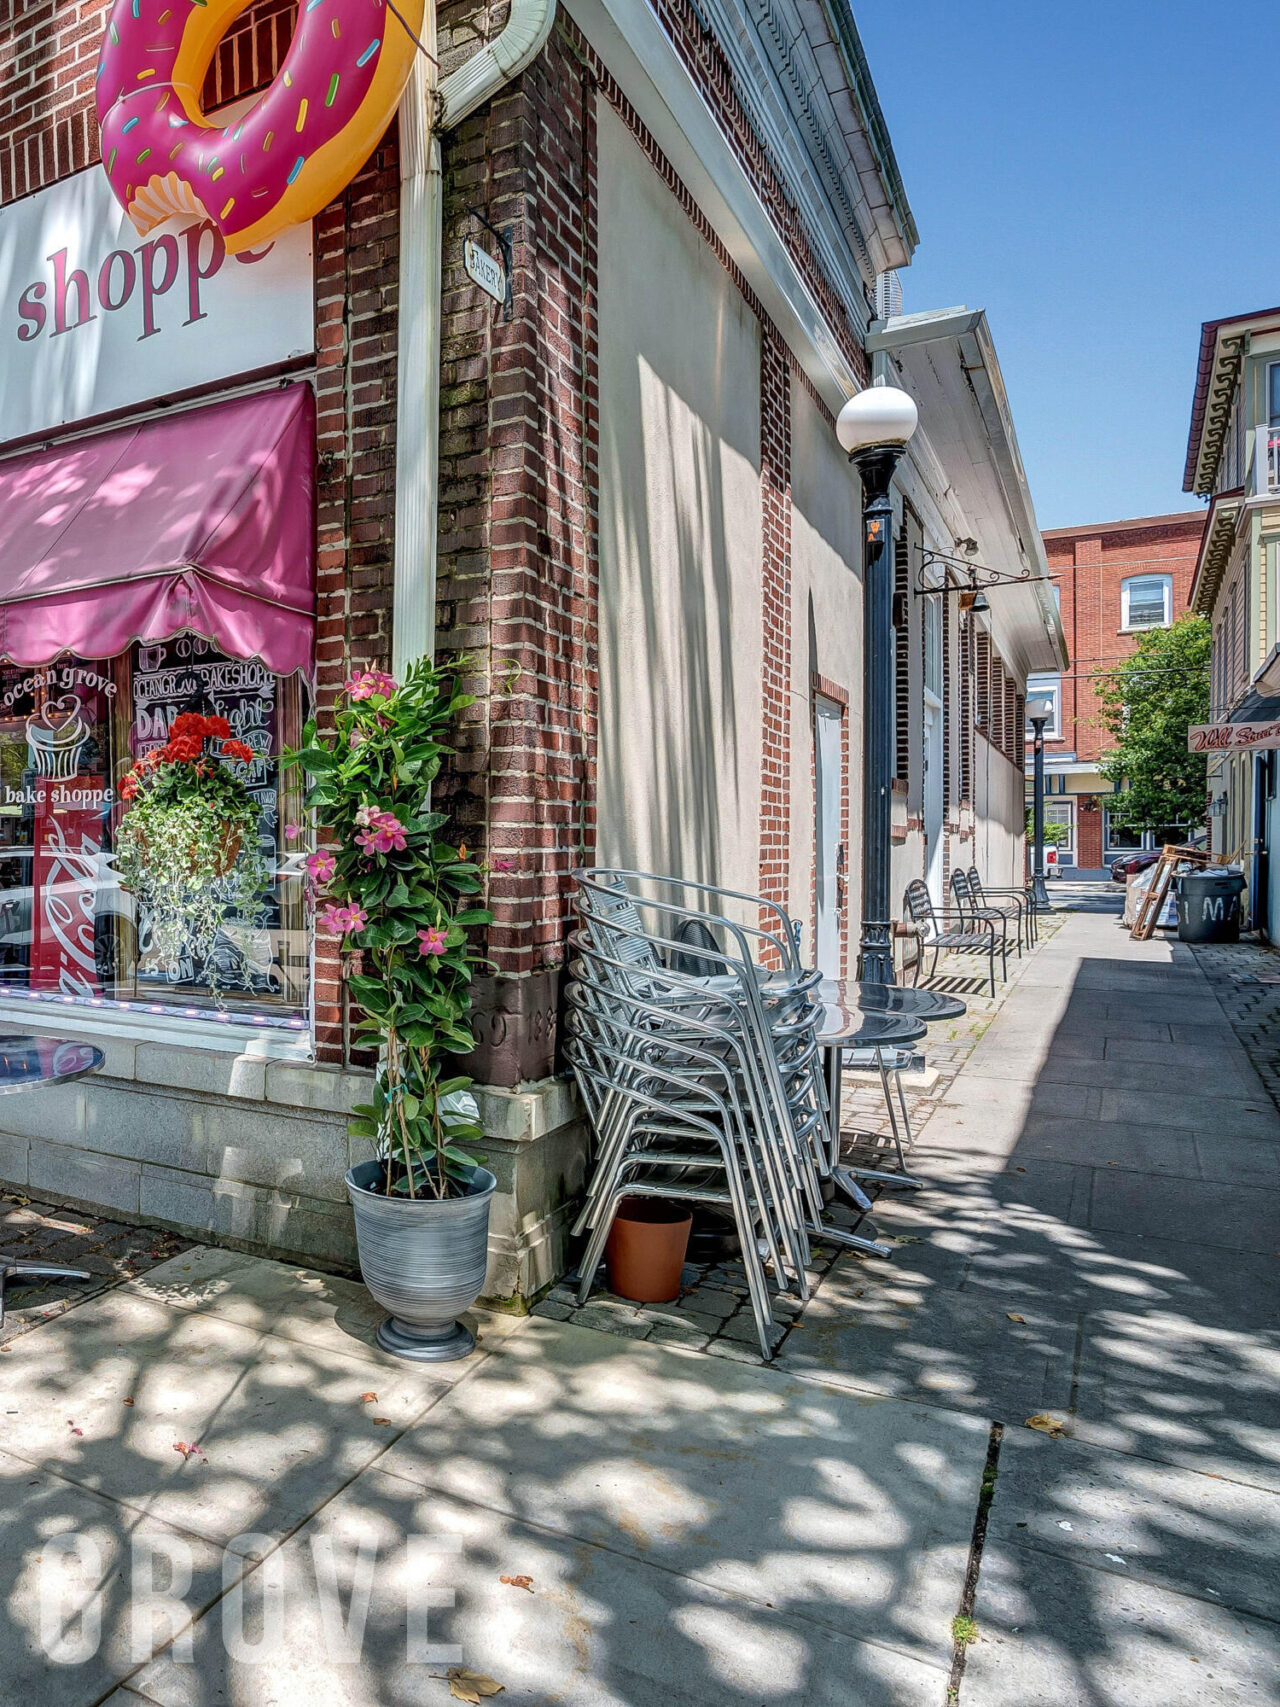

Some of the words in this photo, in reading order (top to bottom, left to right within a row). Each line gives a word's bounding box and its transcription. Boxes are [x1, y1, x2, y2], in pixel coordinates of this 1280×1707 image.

[3, 669, 58, 707] ocean
[59, 667, 118, 699] grove
[136, 705, 179, 740] DA
[1190, 726, 1233, 751] Wall
[4, 785, 47, 803] bake
[50, 784, 114, 809] shoppe
[169, 958, 195, 981] ON
